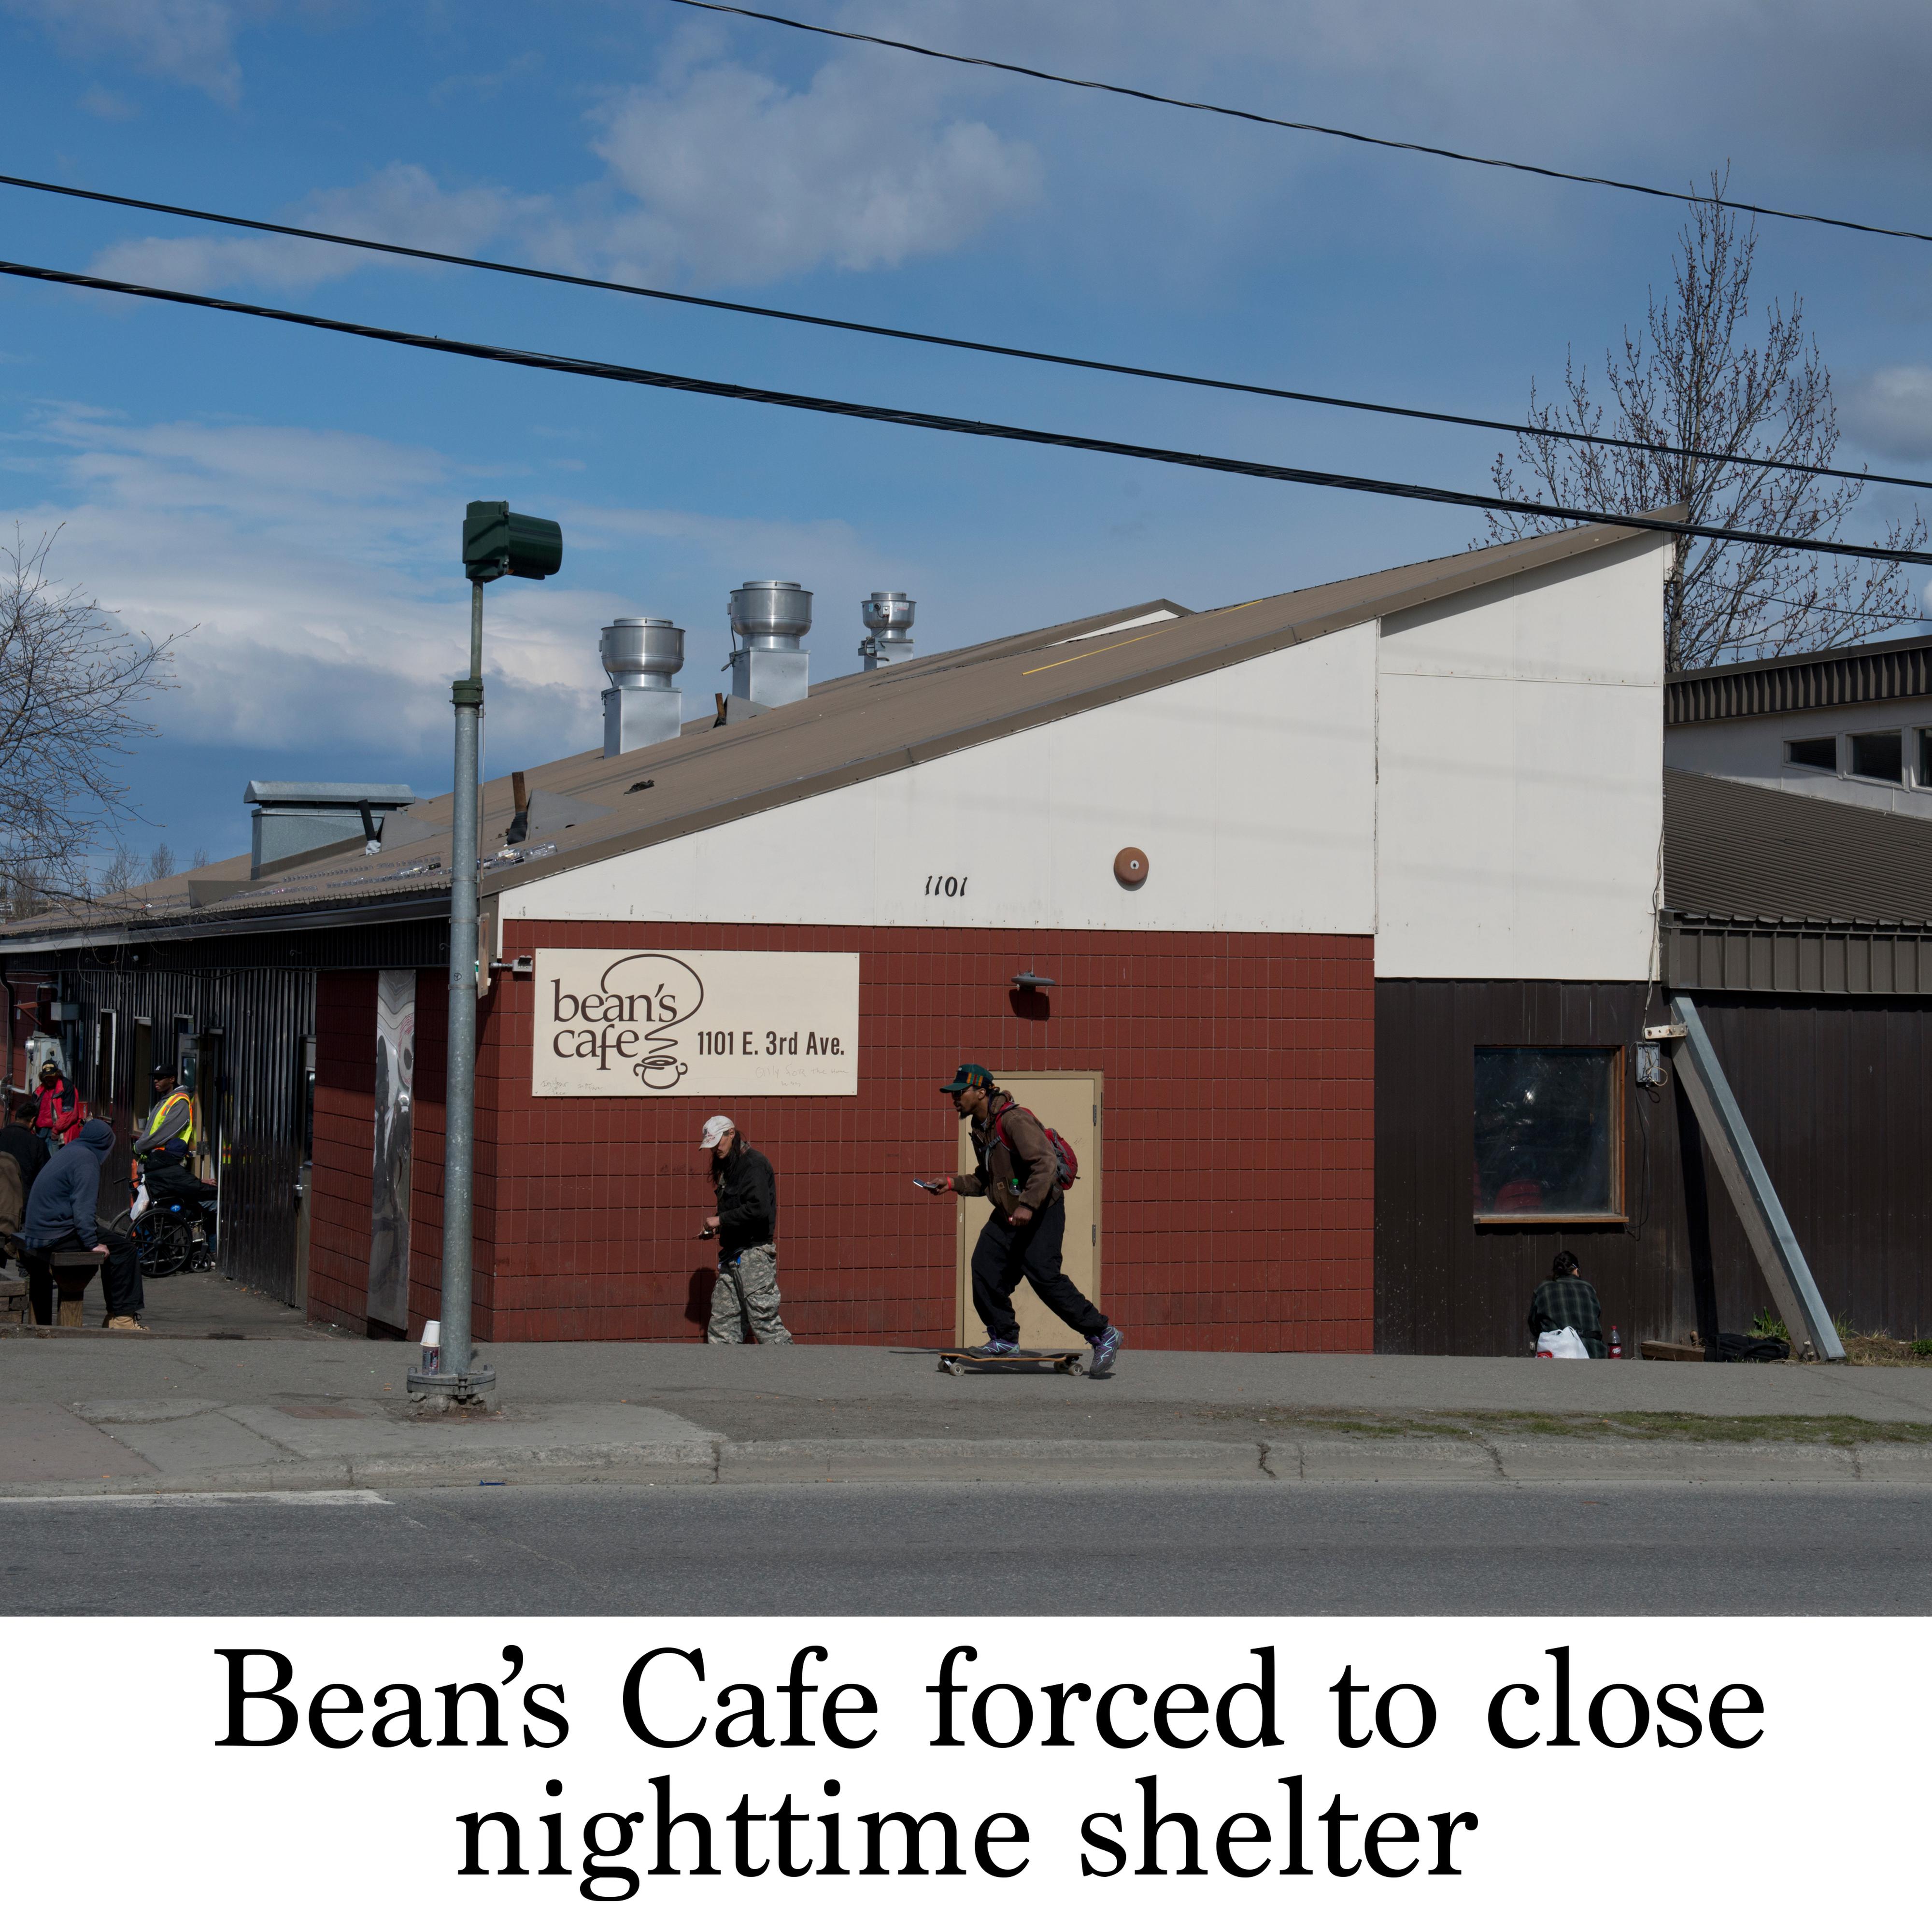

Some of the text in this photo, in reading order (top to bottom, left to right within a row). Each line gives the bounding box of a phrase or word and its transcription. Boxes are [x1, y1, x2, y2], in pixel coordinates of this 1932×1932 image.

[925, 876, 968, 897] 1101
[551, 979, 677, 1023] bean's
[553, 1024, 639, 1070] cafe
[697, 1031, 844, 1055] 1101 E. 3rd Ave.
